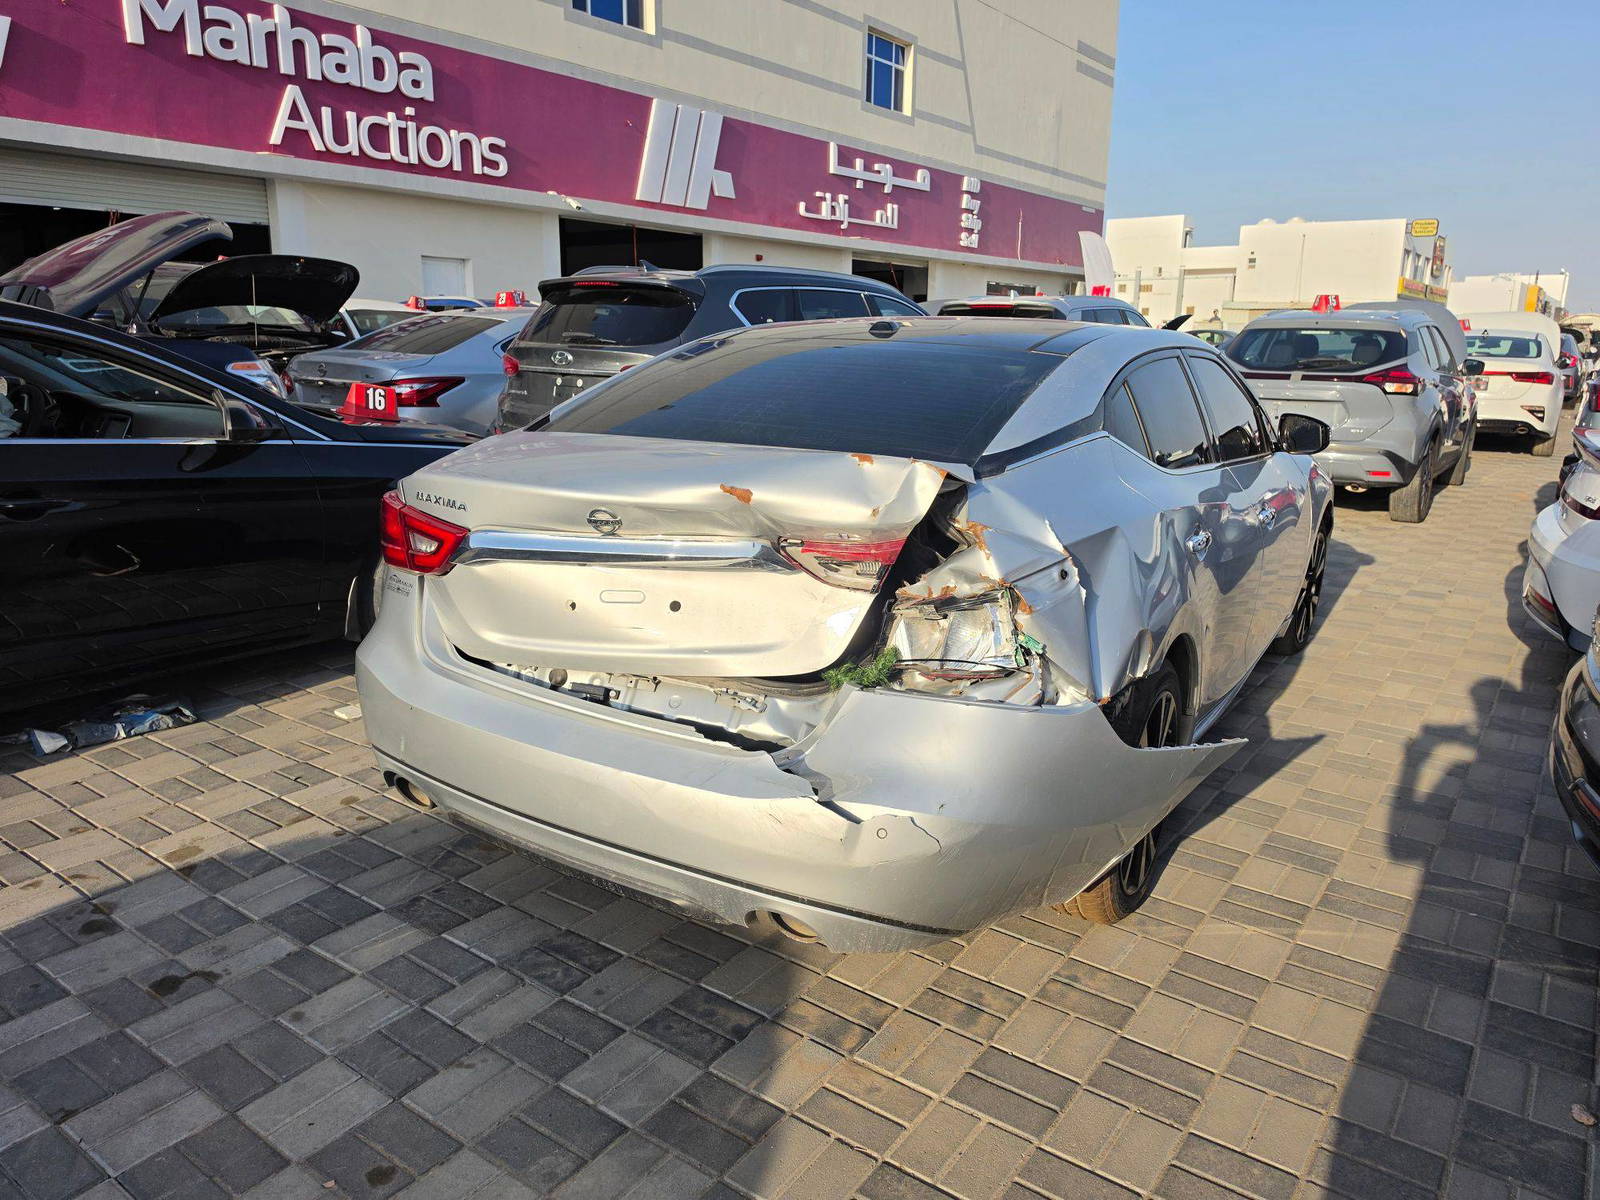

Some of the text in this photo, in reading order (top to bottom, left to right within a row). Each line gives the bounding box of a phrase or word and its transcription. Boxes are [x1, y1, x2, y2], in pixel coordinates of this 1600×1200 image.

[121, 0, 435, 102] Marhaba
[268, 84, 509, 177] Auctions
[366, 387, 386, 411] 16
[416, 491, 467, 511] MAXIMA
